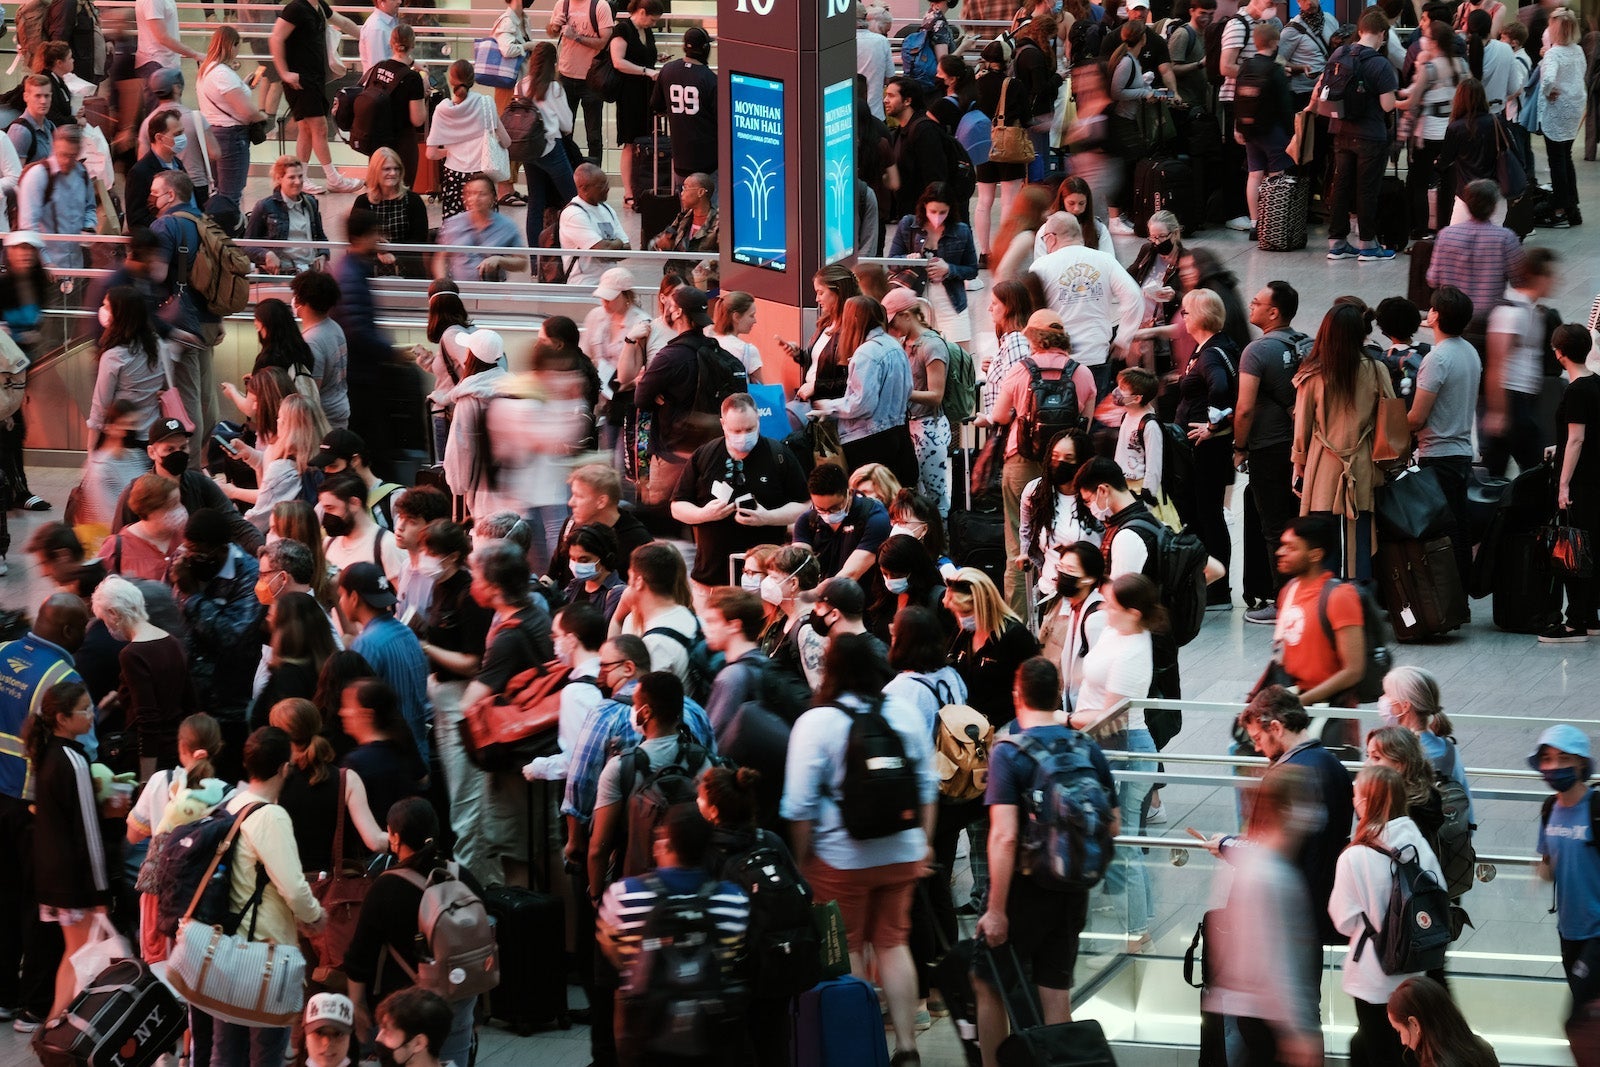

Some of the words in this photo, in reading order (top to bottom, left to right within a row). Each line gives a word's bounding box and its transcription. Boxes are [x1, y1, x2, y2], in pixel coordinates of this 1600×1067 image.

[669, 84, 700, 115] 99
[734, 100, 781, 120] MOYNIHAN
[734, 115, 760, 131] TRAIN
[761, 120, 783, 135] HALL
[1059, 263, 1101, 287] COSTA
[0, 671, 28, 690] ustomer
[133, 1004, 166, 1046] NY
